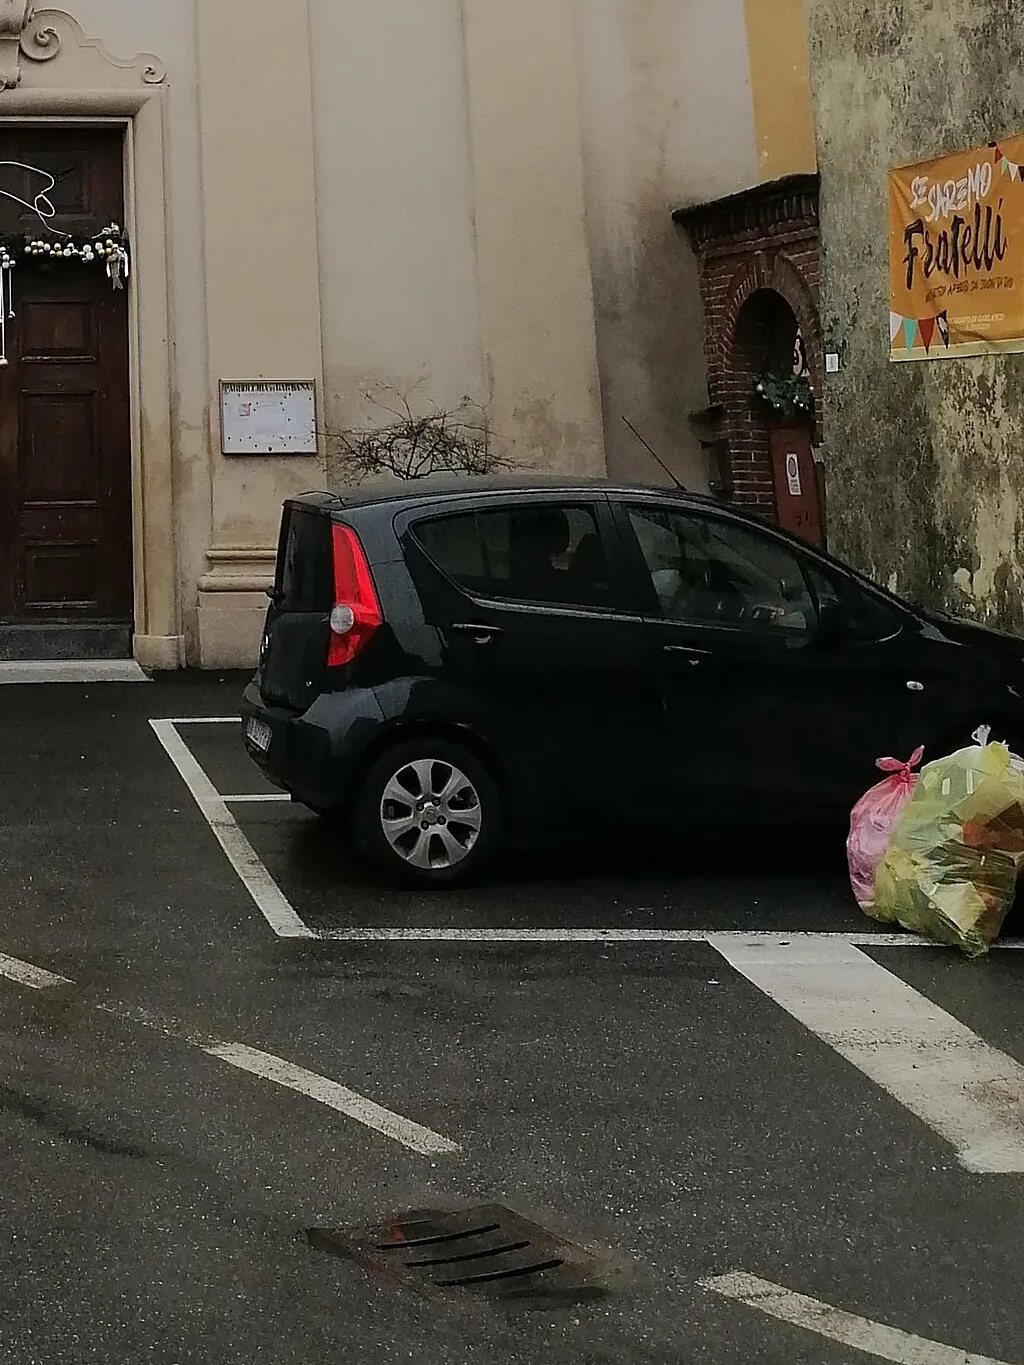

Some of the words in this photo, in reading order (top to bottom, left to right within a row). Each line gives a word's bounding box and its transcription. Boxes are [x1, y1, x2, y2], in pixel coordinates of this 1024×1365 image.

[910, 176, 929, 209] SE
[925, 162, 992, 222] SAREMO
[902, 198, 1008, 290] Fratelli
